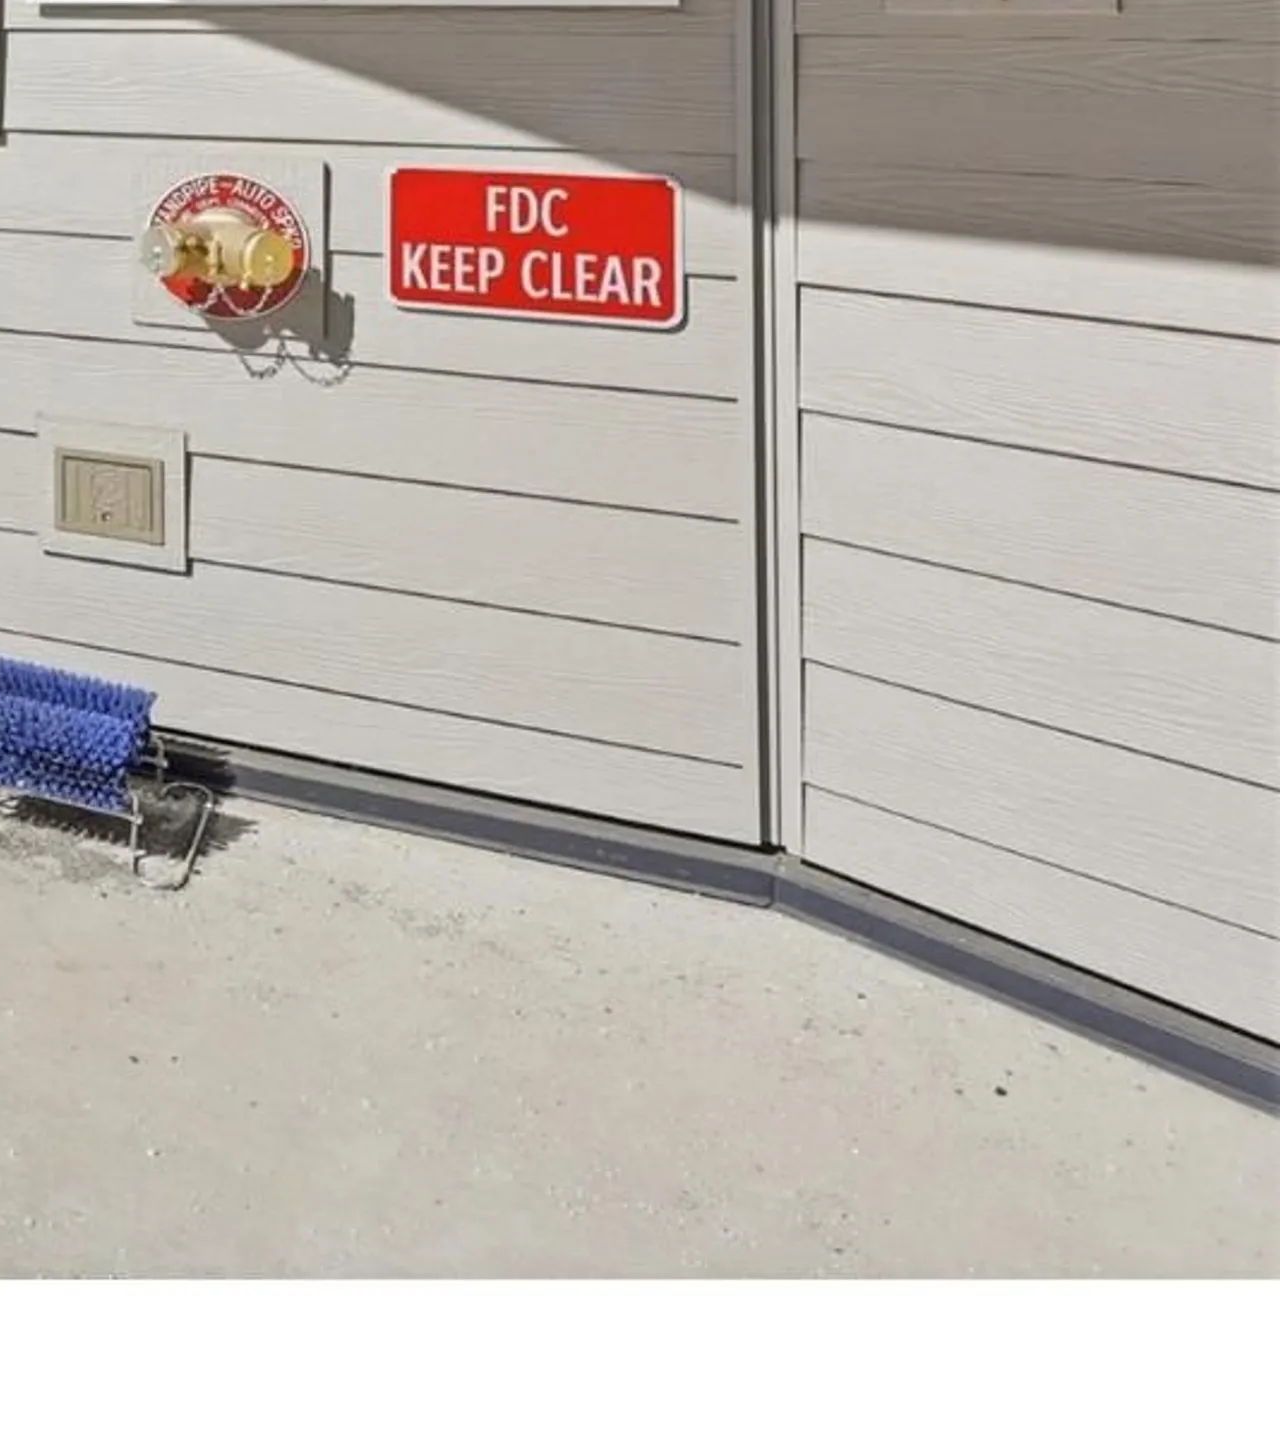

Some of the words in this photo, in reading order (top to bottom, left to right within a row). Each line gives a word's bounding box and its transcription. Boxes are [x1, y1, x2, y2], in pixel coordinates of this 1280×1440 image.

[486, 185, 569, 238] FDC
[401, 242, 505, 294] KEEP
[520, 250, 662, 307] CLEAR
